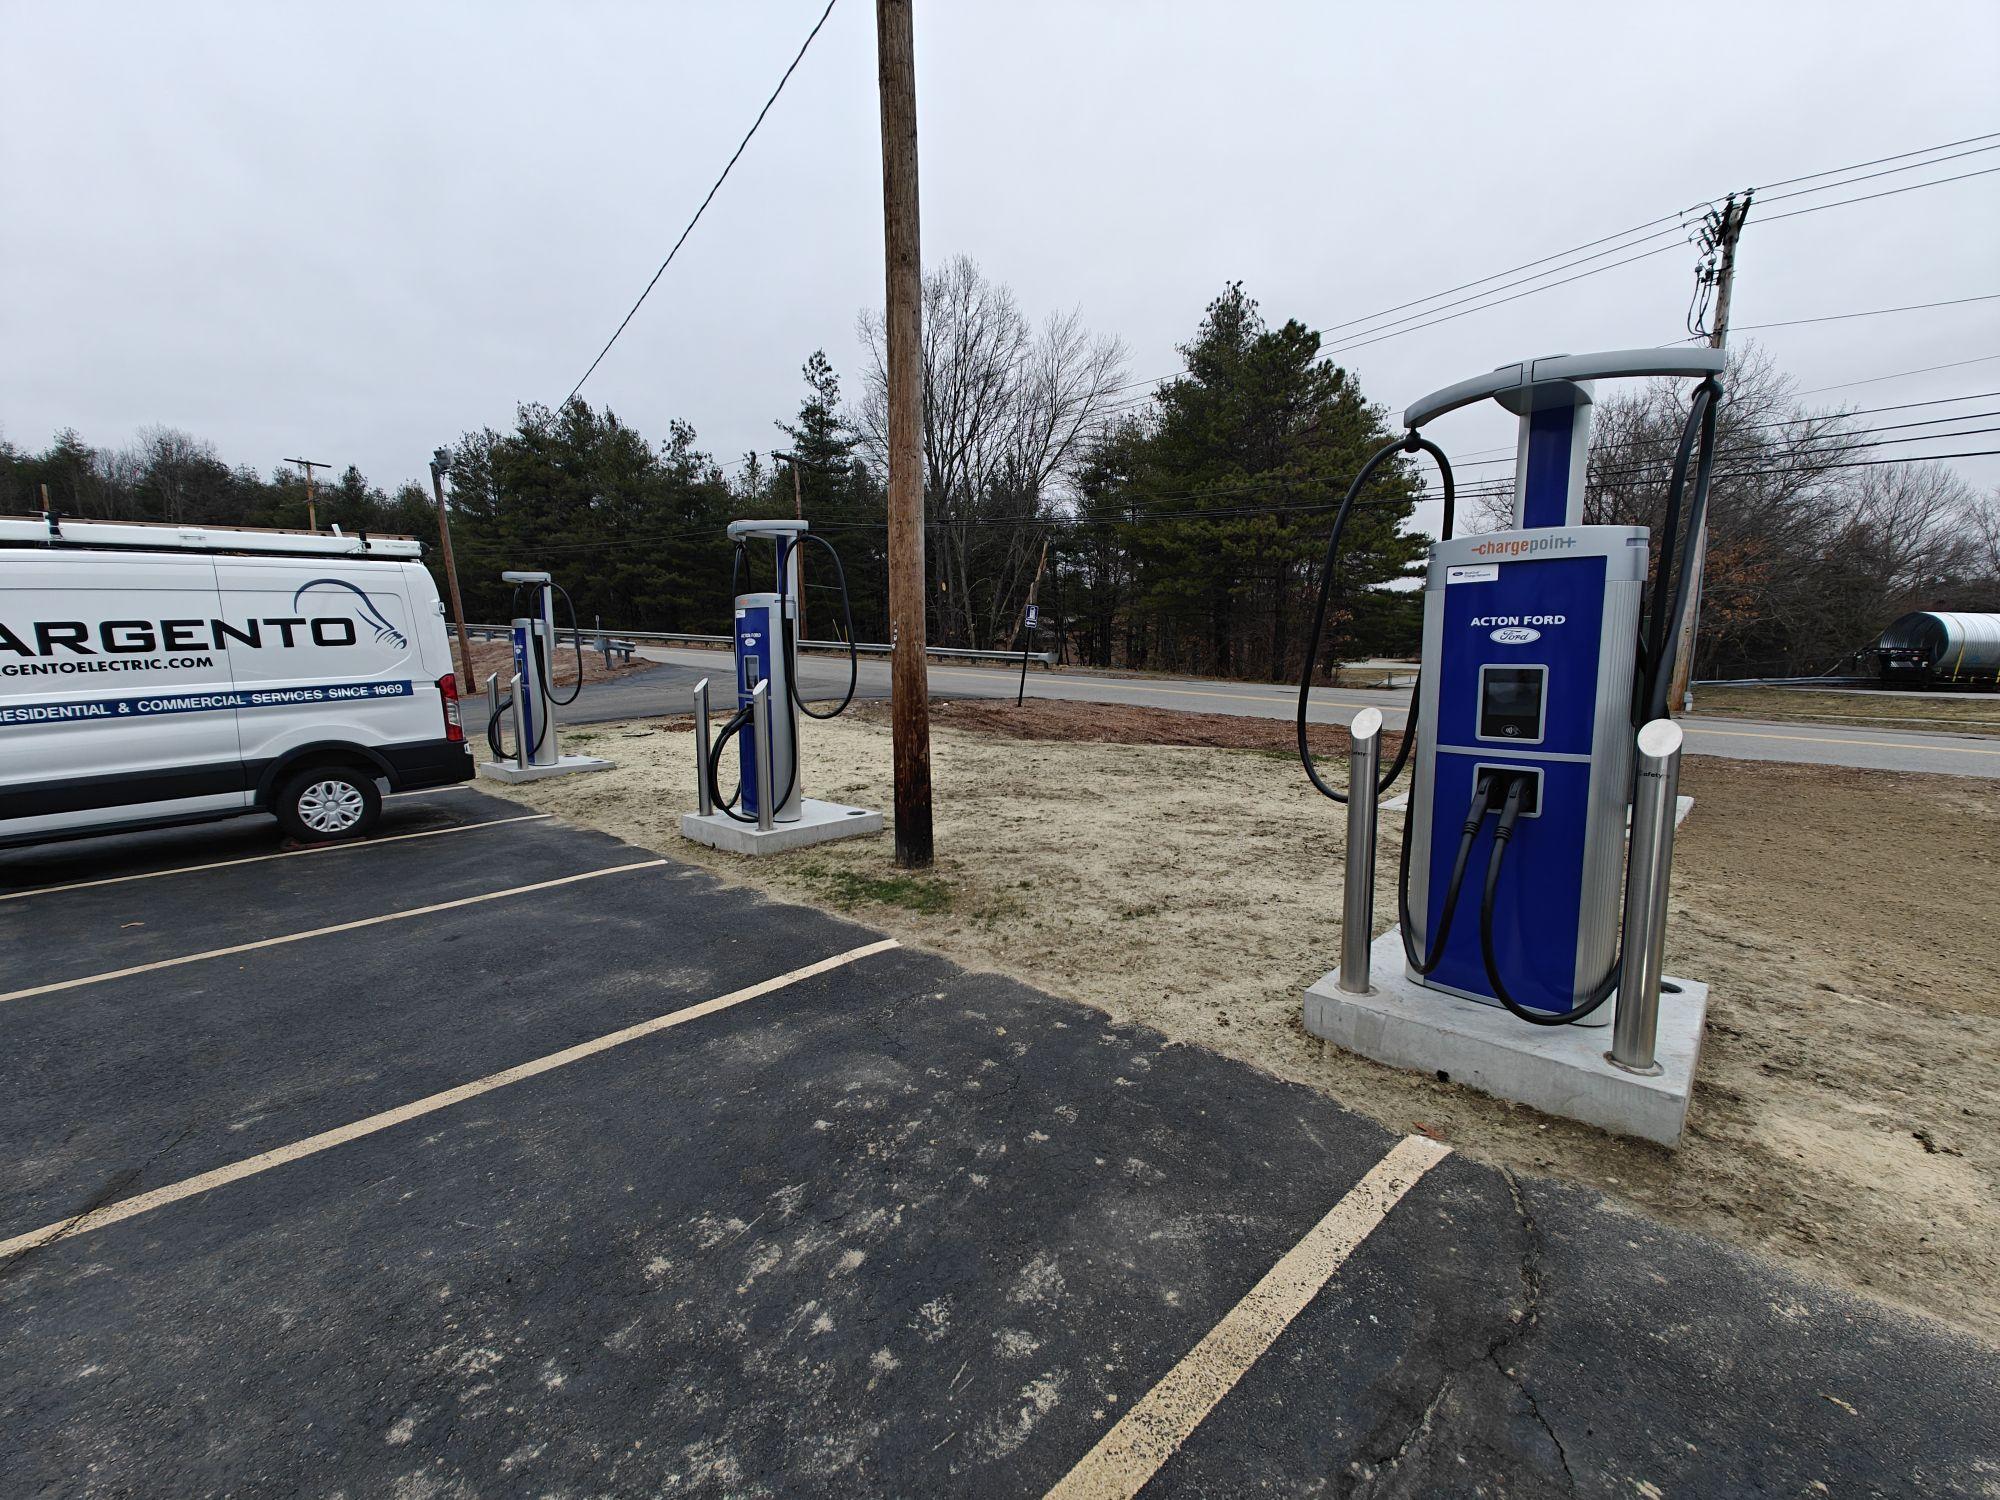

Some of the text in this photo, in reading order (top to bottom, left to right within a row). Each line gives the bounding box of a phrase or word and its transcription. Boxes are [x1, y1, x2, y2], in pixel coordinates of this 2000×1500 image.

[1470, 614, 1566, 627] ACTON FORD
[1500, 629, 1530, 641] Ford
[0, 656, 214, 677] GENTOELECTRIC.COM
[0, 684, 403, 722] ESIDENTIAL & COMMERCIAL SERVICES SINCE 1969
[1639, 771, 1663, 779] afety
